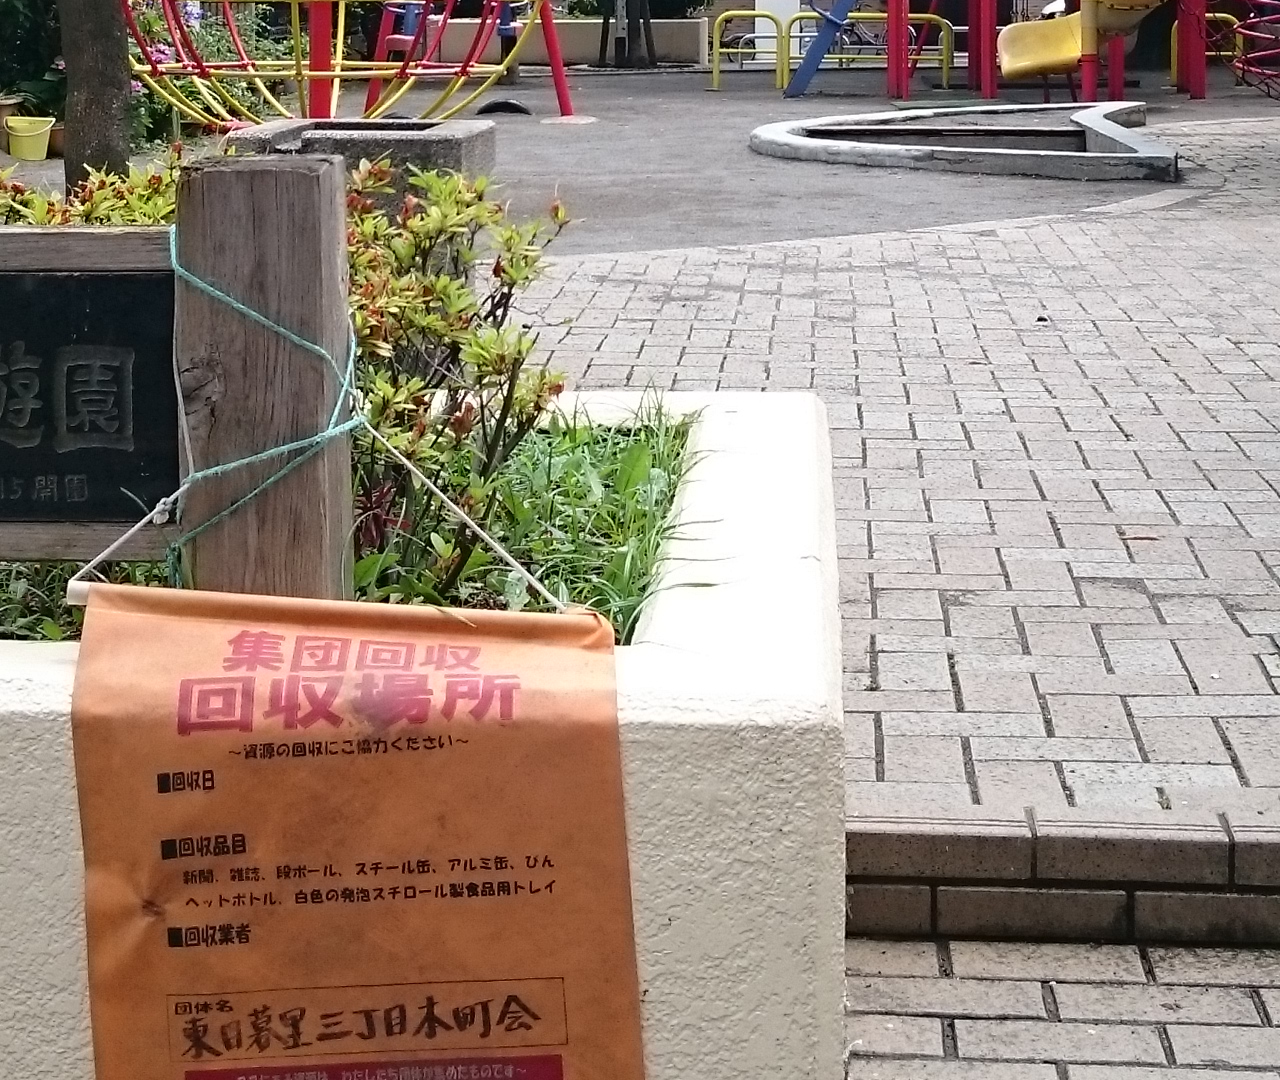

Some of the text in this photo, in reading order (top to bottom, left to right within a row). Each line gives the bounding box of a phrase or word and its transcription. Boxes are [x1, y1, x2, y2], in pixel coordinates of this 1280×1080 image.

[221, 629, 483, 672] 集団回収
[177, 672, 522, 736] 回収場所
[174, 999, 235, 1016] 団体名
